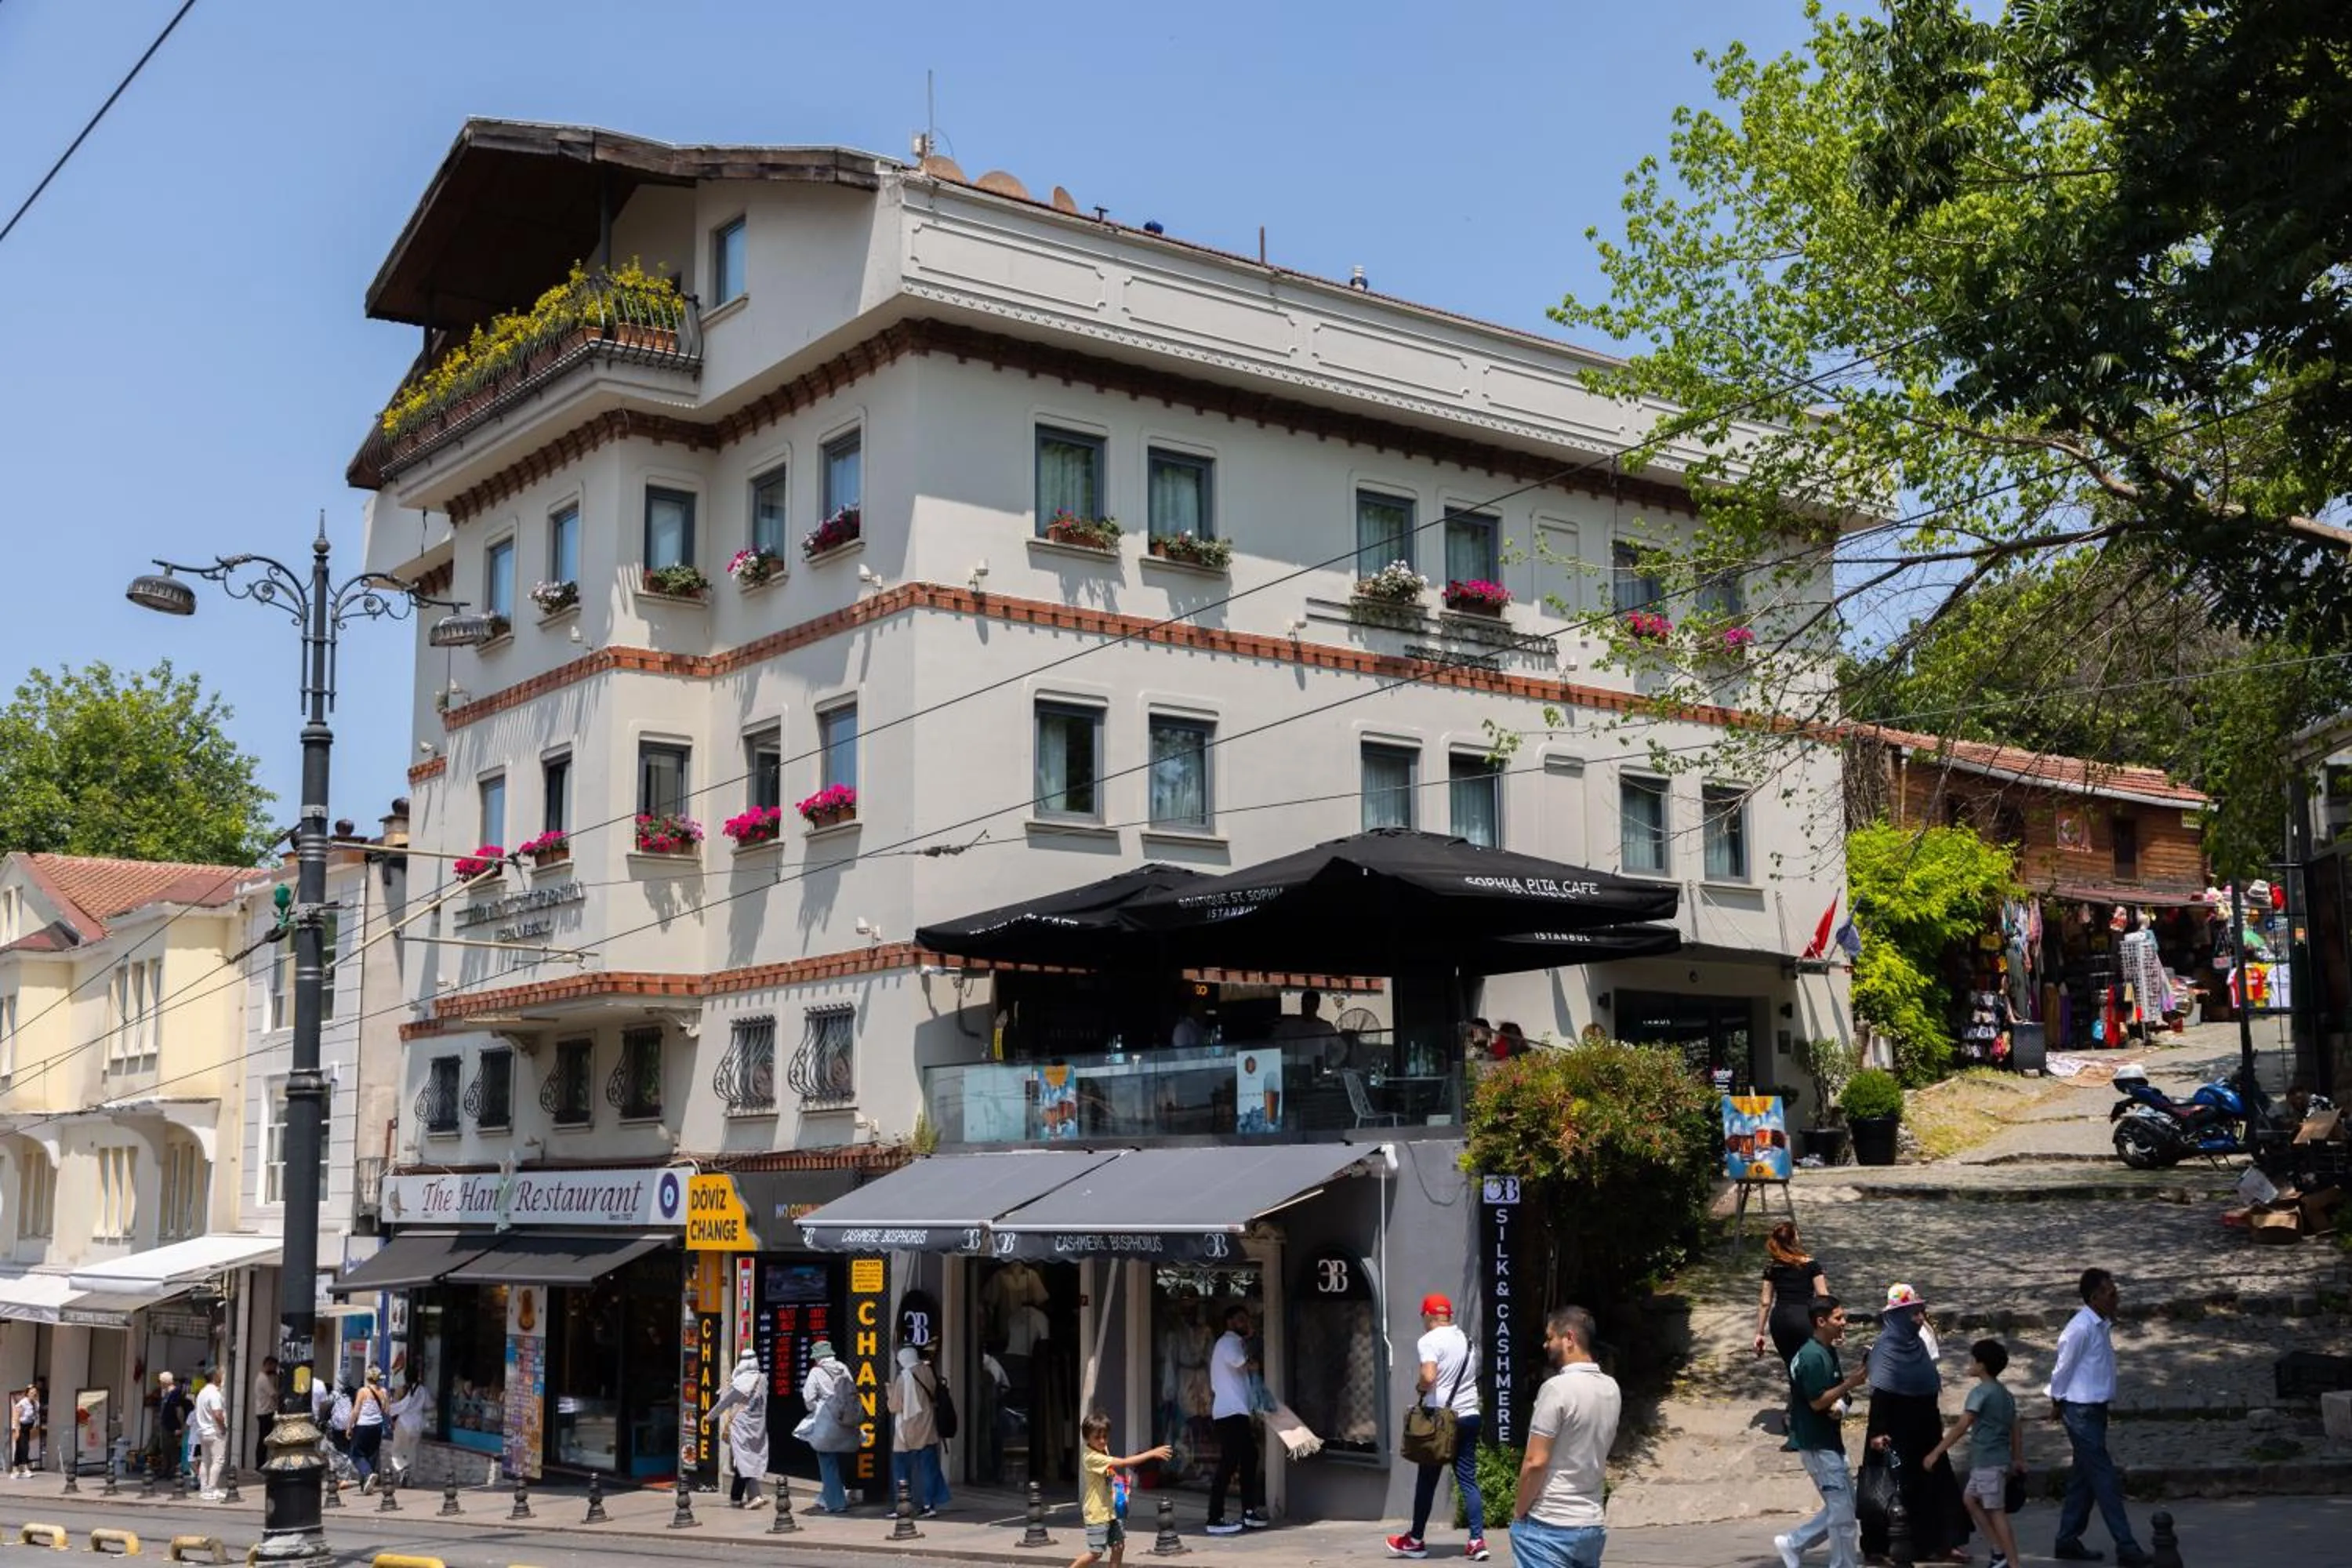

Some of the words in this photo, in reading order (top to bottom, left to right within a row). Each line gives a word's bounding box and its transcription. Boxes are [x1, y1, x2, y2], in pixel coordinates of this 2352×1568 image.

[1465, 876, 1522, 893] SOPHIA
[1526, 878, 1559, 892] PITA
[1563, 880, 1600, 895] CAFE
[1534, 931, 1591, 942] ISTANBUL
[422, 1178, 452, 1212] The
[456, 1177, 500, 1212] Han
[515, 1179, 644, 1212] Restaurant
[689, 1219, 738, 1242] CHANGE
[1054, 1235, 1105, 1252] CASHMERE
[1495, 1208, 1509, 1276] SILK
[1495, 1282, 1510, 1297] &
[1495, 1304, 1512, 1443] CASHMERE
[700, 1318, 712, 1460] CHANGE
[856, 1301, 877, 1479] CHANGE
